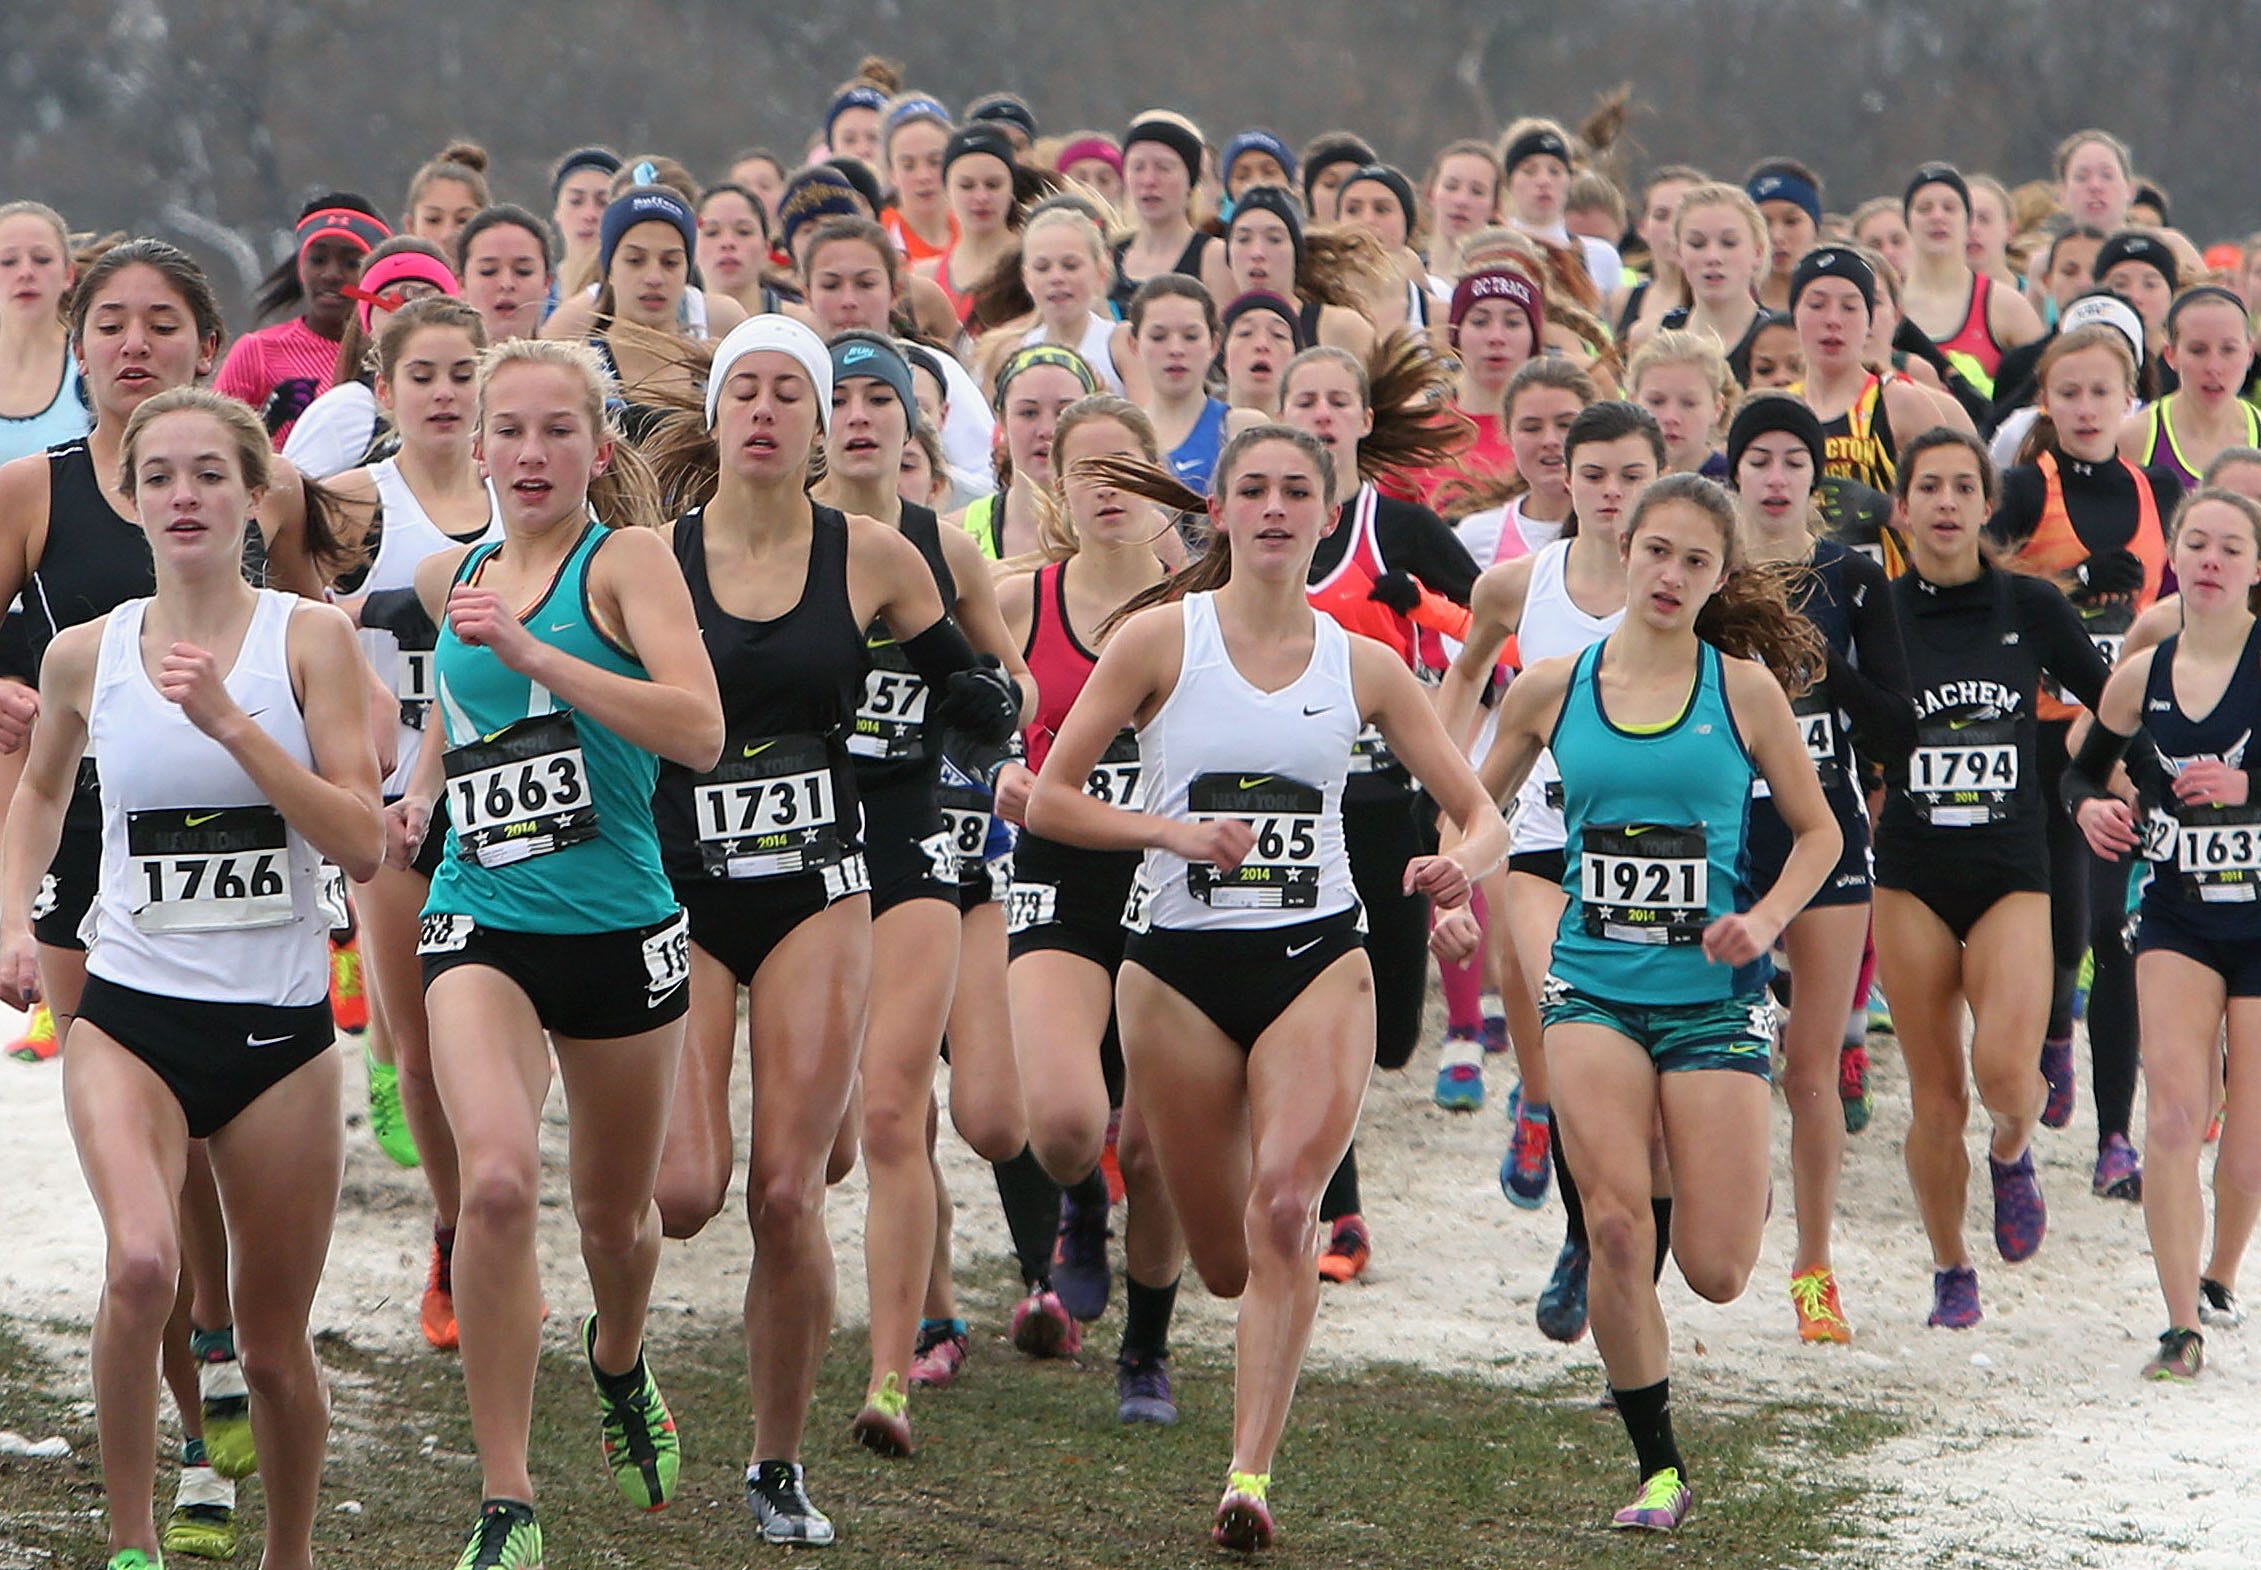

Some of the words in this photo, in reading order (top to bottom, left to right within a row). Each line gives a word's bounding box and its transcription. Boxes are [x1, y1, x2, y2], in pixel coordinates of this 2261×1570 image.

[871, 675, 925, 717] 57
[1087, 766, 1142, 805] 87
[1918, 751, 2014, 786] 1794
[458, 757, 581, 826] 1663
[707, 776, 823, 833] 1731
[1210, 793, 1249, 810] NEW
[1254, 793, 1299, 810] YORK
[1953, 791, 1980, 803] 2014
[504, 820, 538, 838] 2014
[757, 833, 788, 849] 2014
[2186, 830, 2261, 866] 163
[143, 854, 283, 902] 1766
[1240, 866, 1271, 881] 2014
[1591, 858, 1695, 903] 1921
[1628, 908, 1656, 922] 2014
